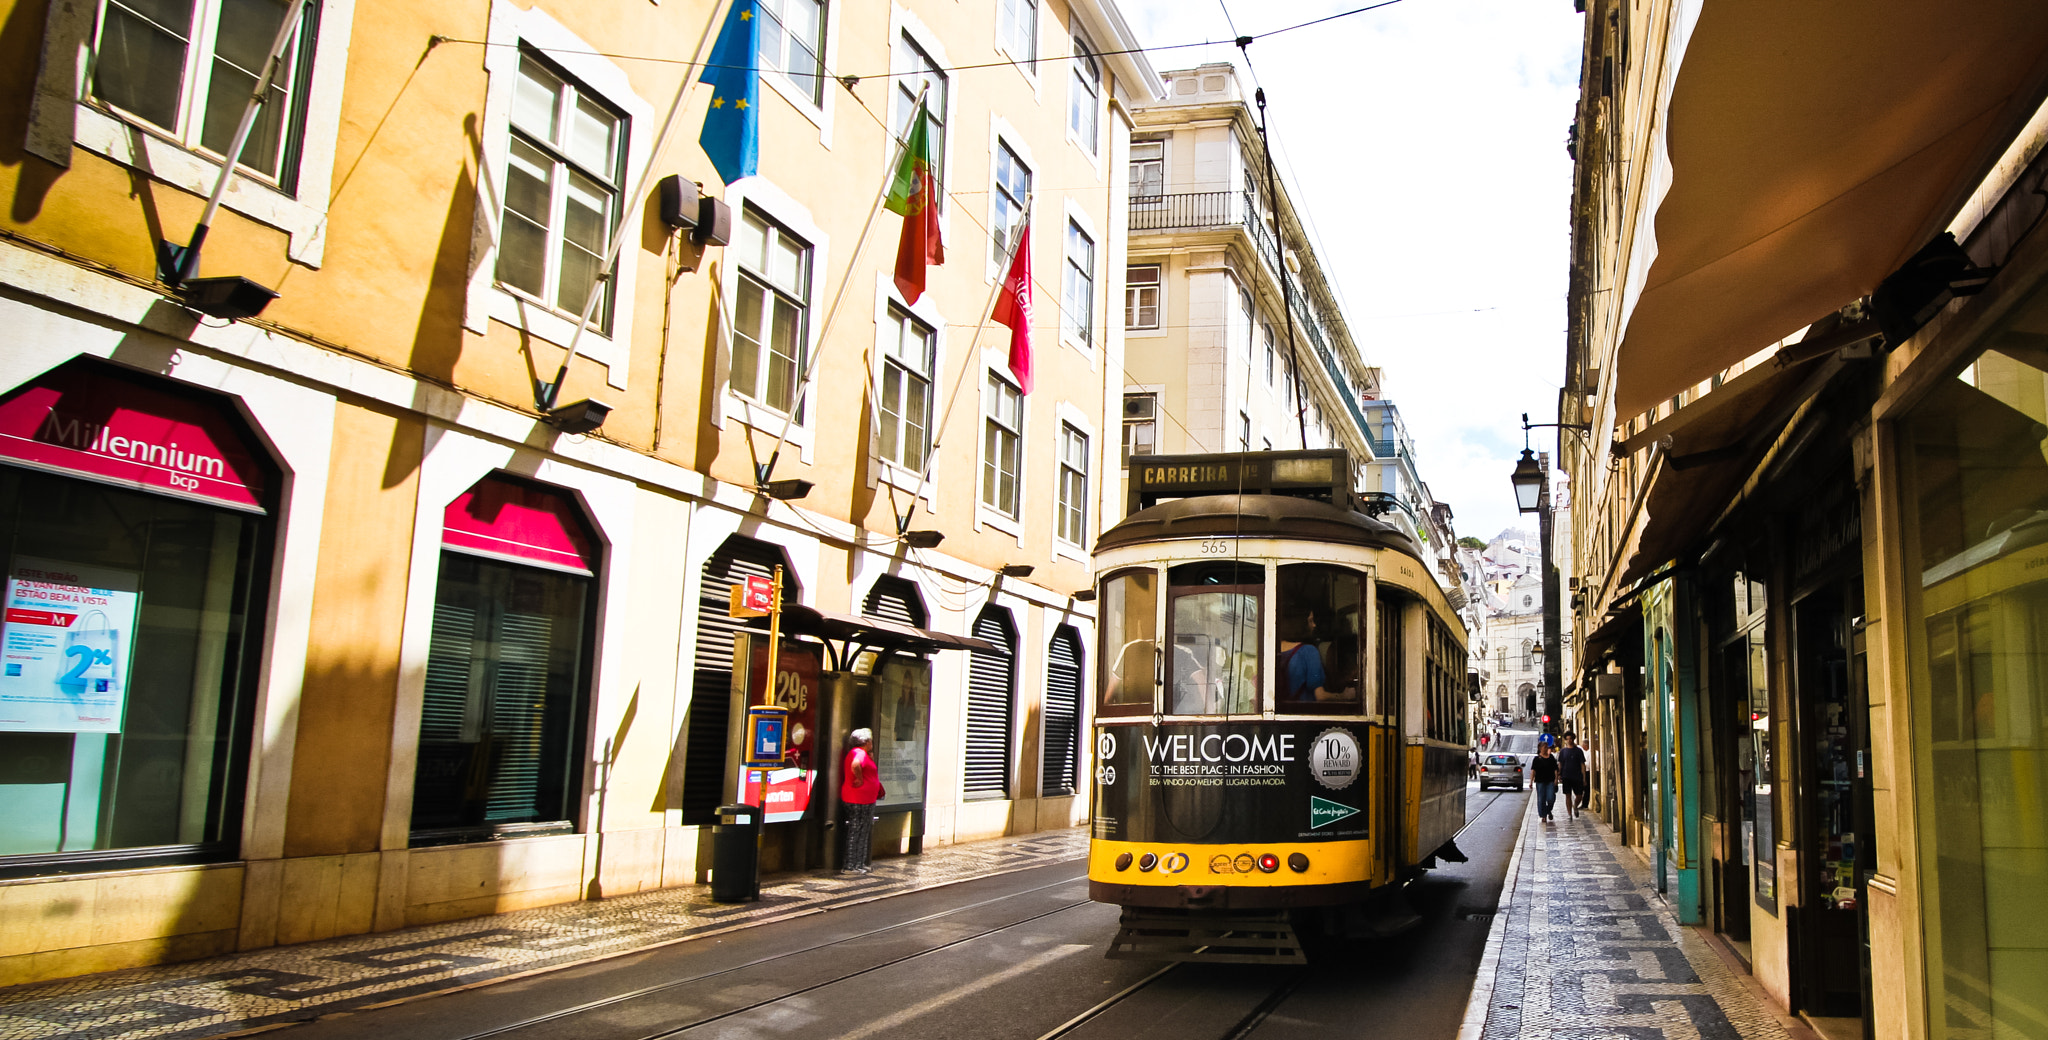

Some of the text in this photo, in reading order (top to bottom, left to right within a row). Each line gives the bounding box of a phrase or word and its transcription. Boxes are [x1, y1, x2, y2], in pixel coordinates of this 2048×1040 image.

[43, 406, 225, 478] Millennium
[169, 471, 200, 491] bcp
[1144, 465, 1228, 484] CARREIRA
[1201, 541, 1227, 553] 565
[18, 569, 78, 582] ESTE VERÃO
[16, 589, 47, 599] ESTÃO
[49, 592, 71, 602] BEM
[82, 596, 108, 605] VISTA
[52, 614, 65, 625] M
[60, 644, 113, 684] 2%
[1143, 733, 1295, 762] WELCOME
[1163, 765, 1178, 775] THE
[1179, 765, 1199, 775] BEST
[1230, 765, 1241, 774] IN
[1242, 765, 1285, 775] FASHION
[1323, 760, 1351, 768] REWARD
[1163, 778, 1184, 786] VINDO
[1184, 778, 1197, 786] AO
[1226, 778, 1249, 786] LUGAR
[1250, 778, 1261, 786] DA
[1262, 778, 1286, 786] MODA
